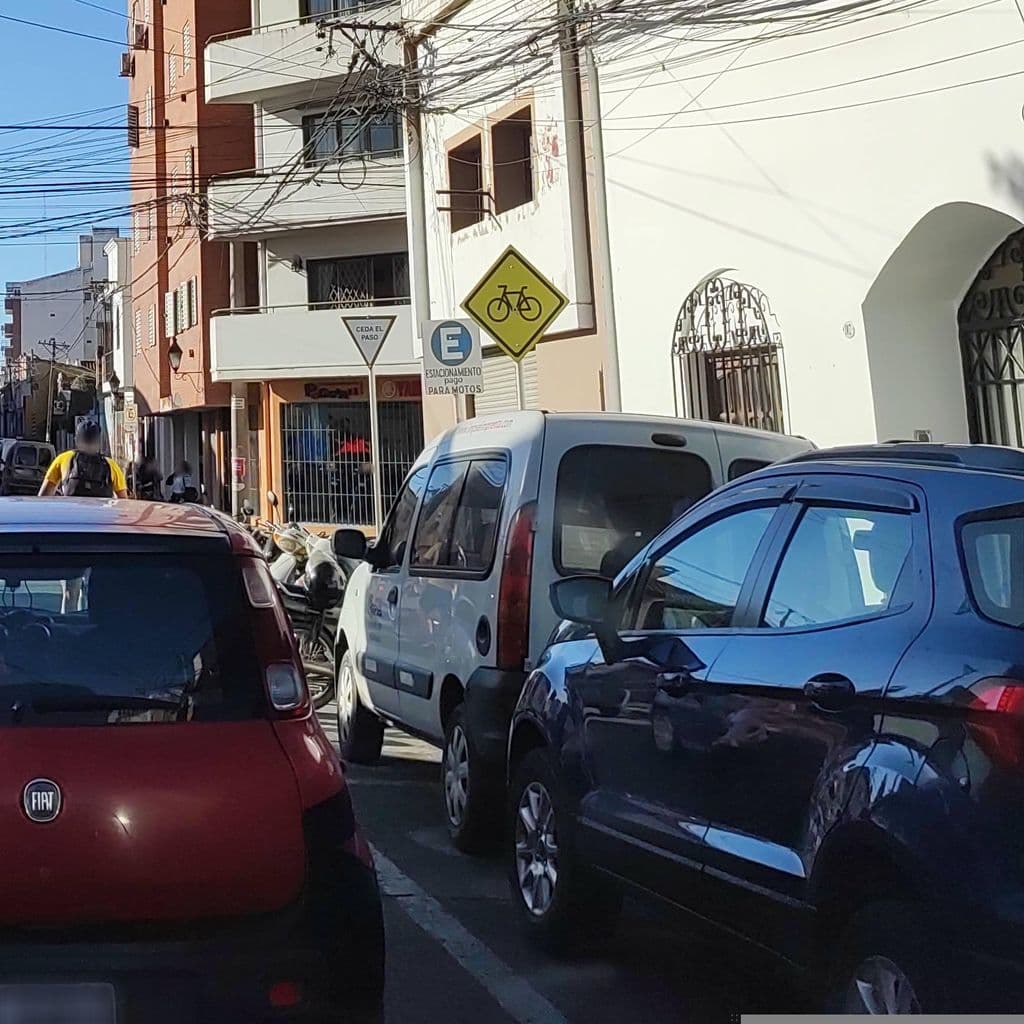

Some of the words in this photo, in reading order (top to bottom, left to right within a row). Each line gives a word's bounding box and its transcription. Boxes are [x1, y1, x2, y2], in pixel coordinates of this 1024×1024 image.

[439, 327, 463, 360] E
[425, 366, 482, 378] ESTACIONAMIENTO
[444, 377, 463, 385] pago
[428, 386, 450, 395] PARA
[451, 384, 482, 394] MOTOS
[32, 791, 54, 811] FIAT
